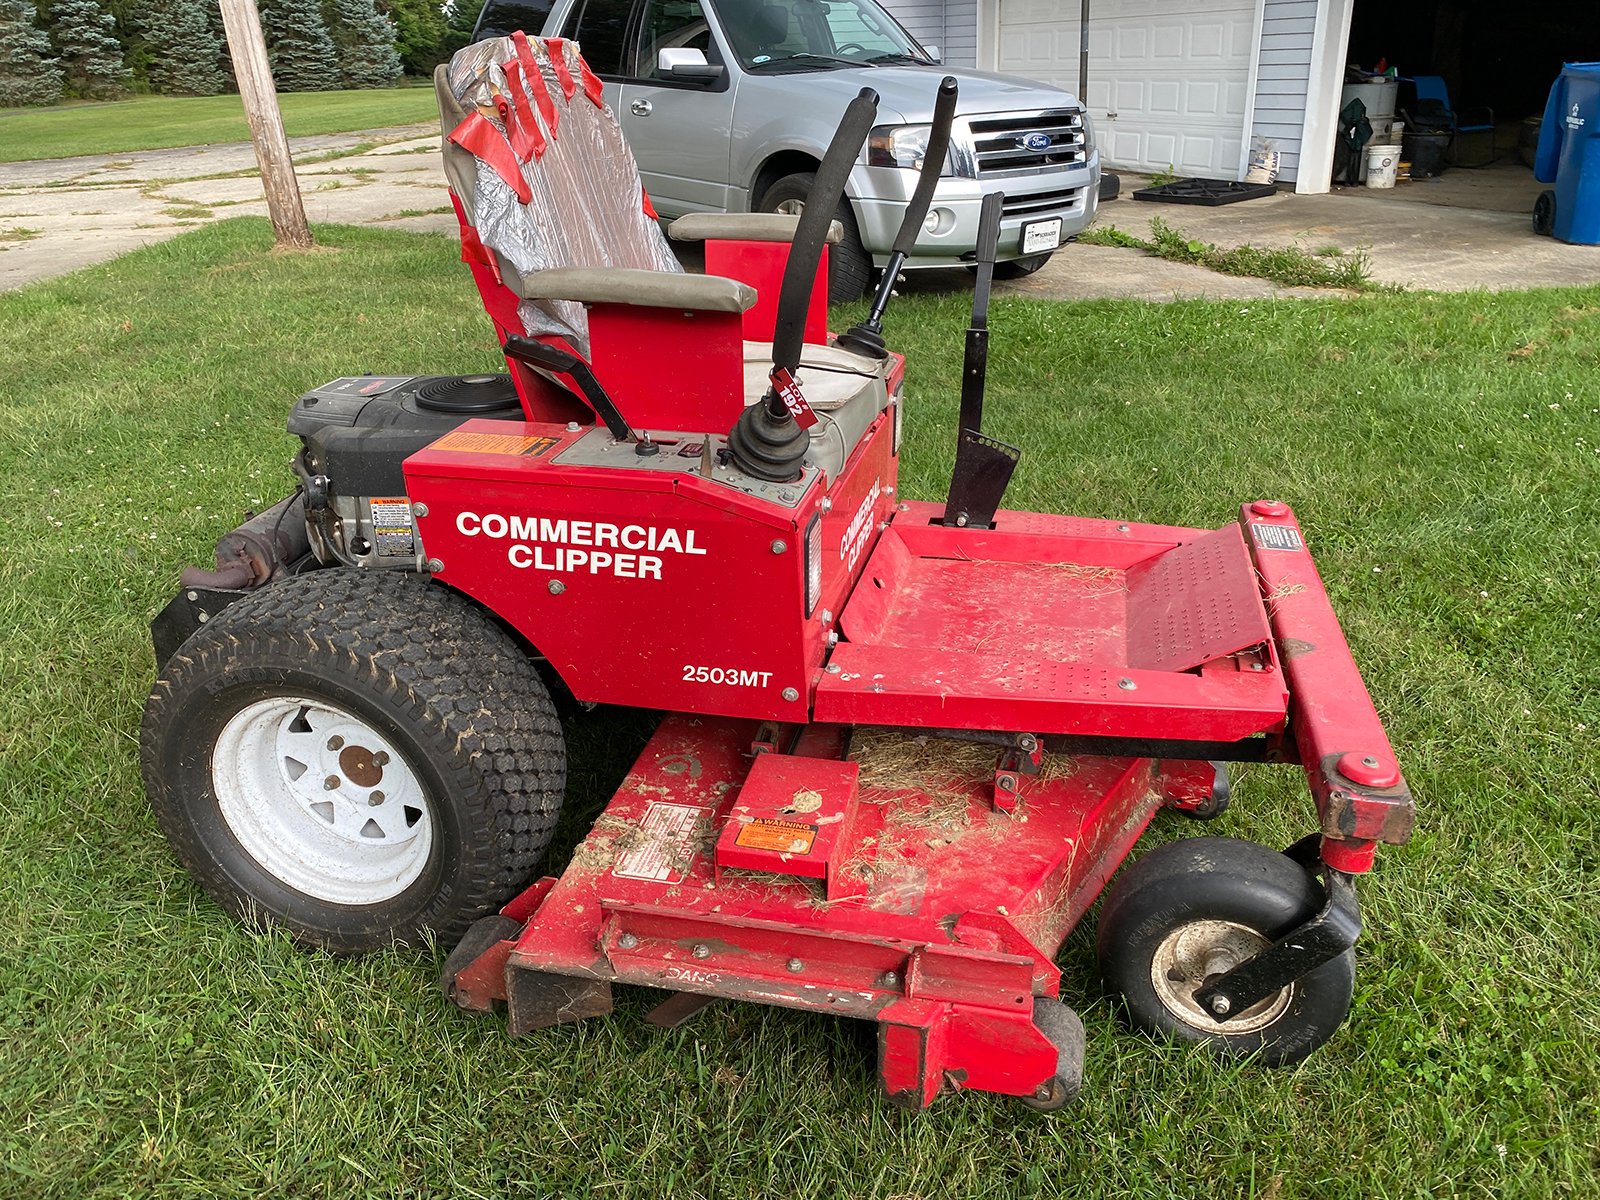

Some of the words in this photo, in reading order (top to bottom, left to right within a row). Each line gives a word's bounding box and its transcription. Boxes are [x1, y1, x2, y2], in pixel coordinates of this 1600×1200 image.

[1031, 135, 1047, 147] Ford
[779, 385, 803, 417] 192
[788, 382, 805, 402] LOT
[840, 475, 881, 561] COMMERCIAL
[456, 511, 706, 555] COMMERCIAL
[507, 544, 663, 580] CLIPPER
[682, 665, 773, 688] 2503MT
[764, 818, 811, 830] WARNING
